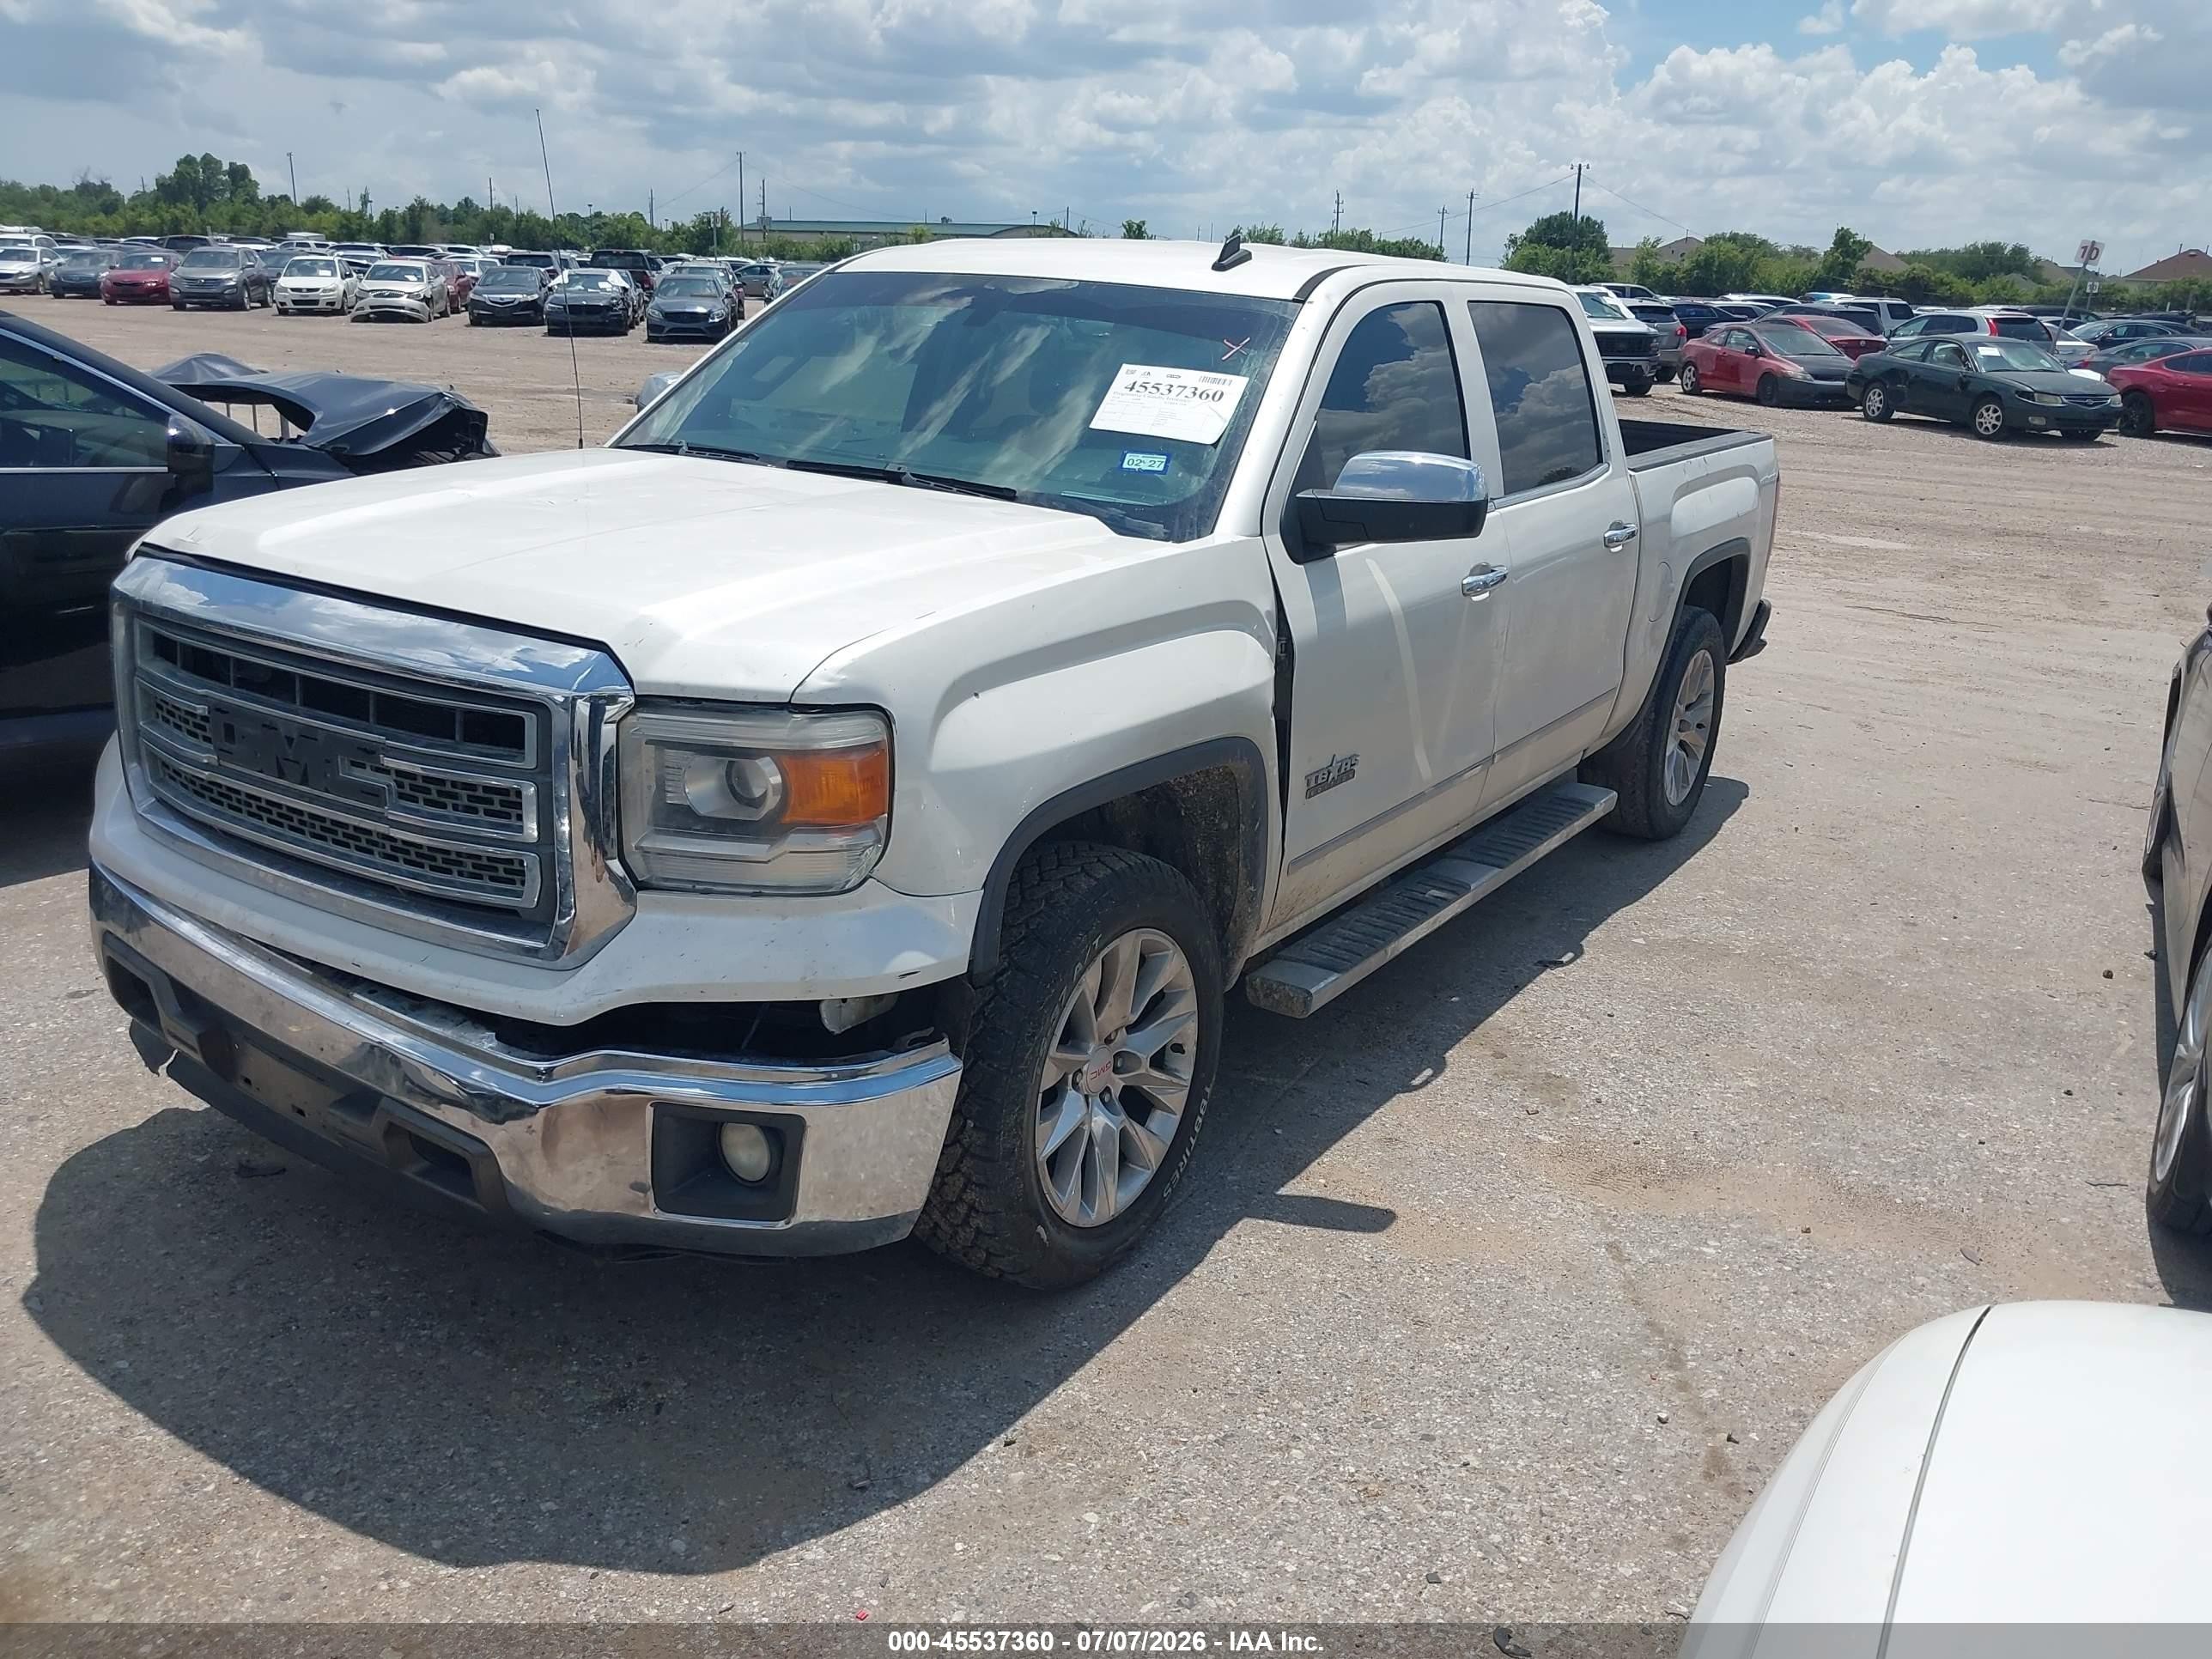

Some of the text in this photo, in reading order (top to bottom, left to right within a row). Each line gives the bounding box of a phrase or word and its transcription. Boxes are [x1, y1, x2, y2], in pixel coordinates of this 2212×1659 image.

[2081, 246, 2100, 260] 10
[1124, 380, 1224, 403] 45537360
[1127, 459, 1142, 467] 02
[1091, 1060, 1111, 1080] GMC
